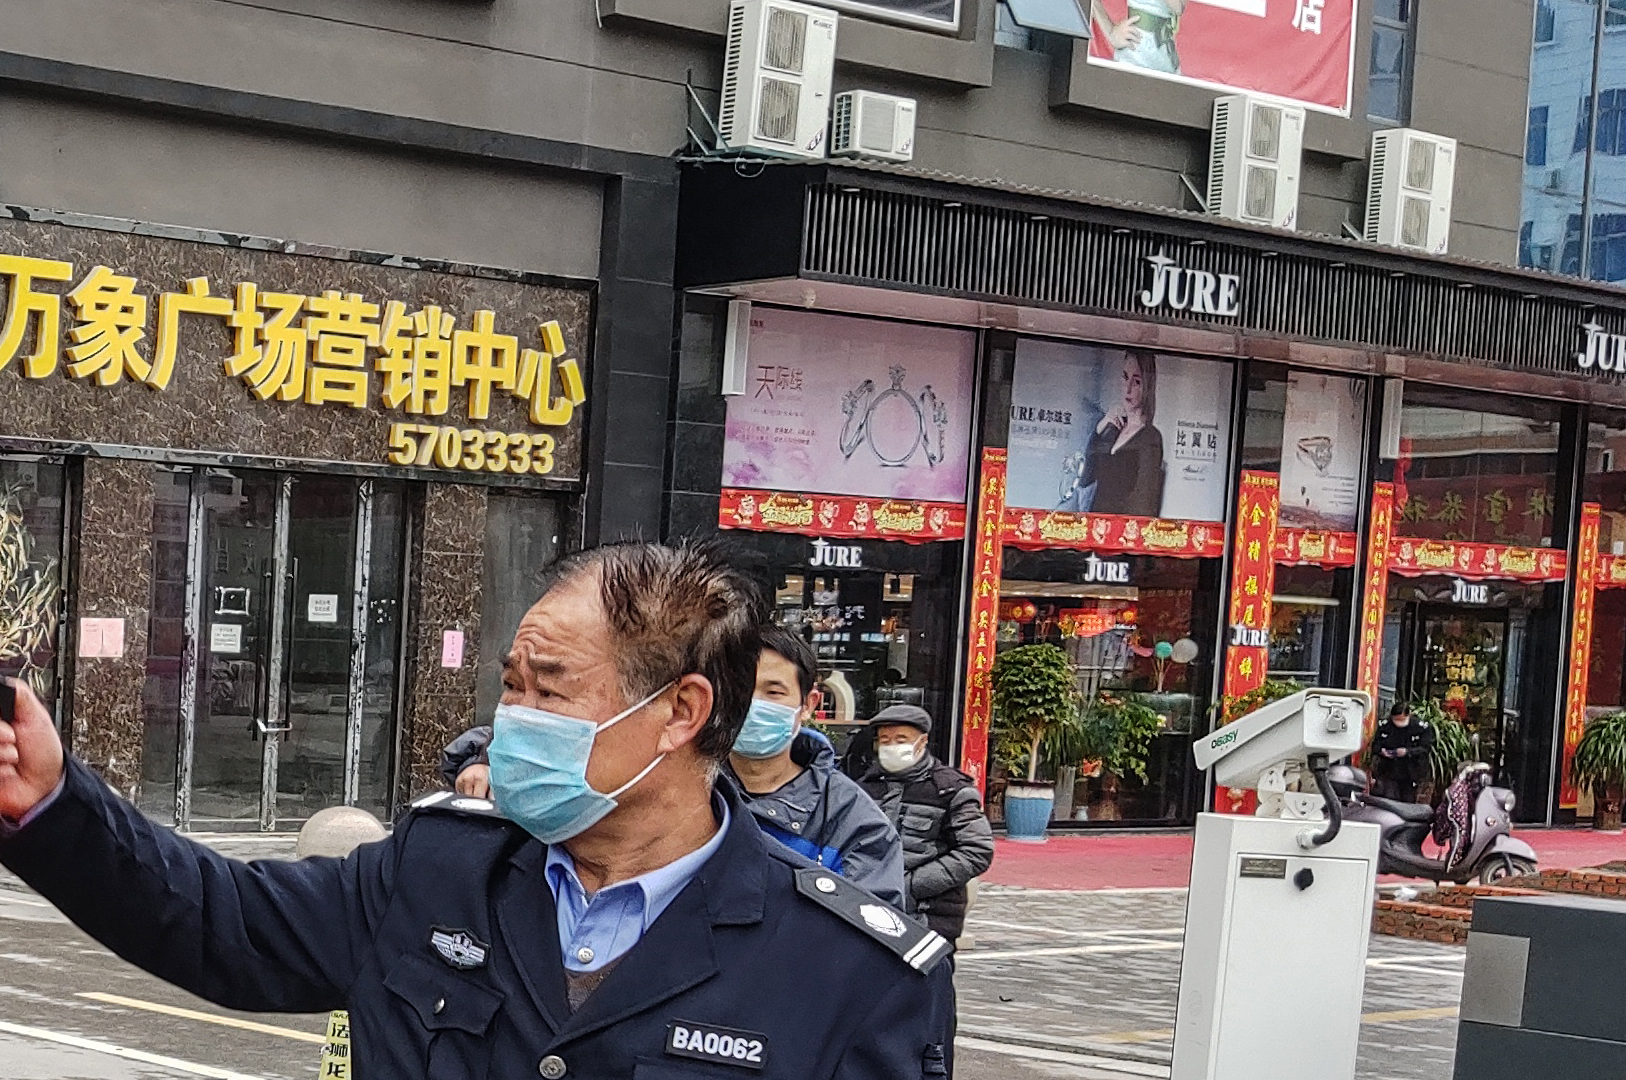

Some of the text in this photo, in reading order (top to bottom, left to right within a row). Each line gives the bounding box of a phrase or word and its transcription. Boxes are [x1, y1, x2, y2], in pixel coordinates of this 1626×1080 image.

[1141, 252, 1240, 316] JURE
[388, 422, 556, 474] 5703333
[810, 538, 862, 567] JURE
[1084, 554, 1129, 582] JURE
[1452, 579, 1488, 603] JURE
[1233, 624, 1269, 646] JURE
[673, 1026, 763, 1062] BA0062
